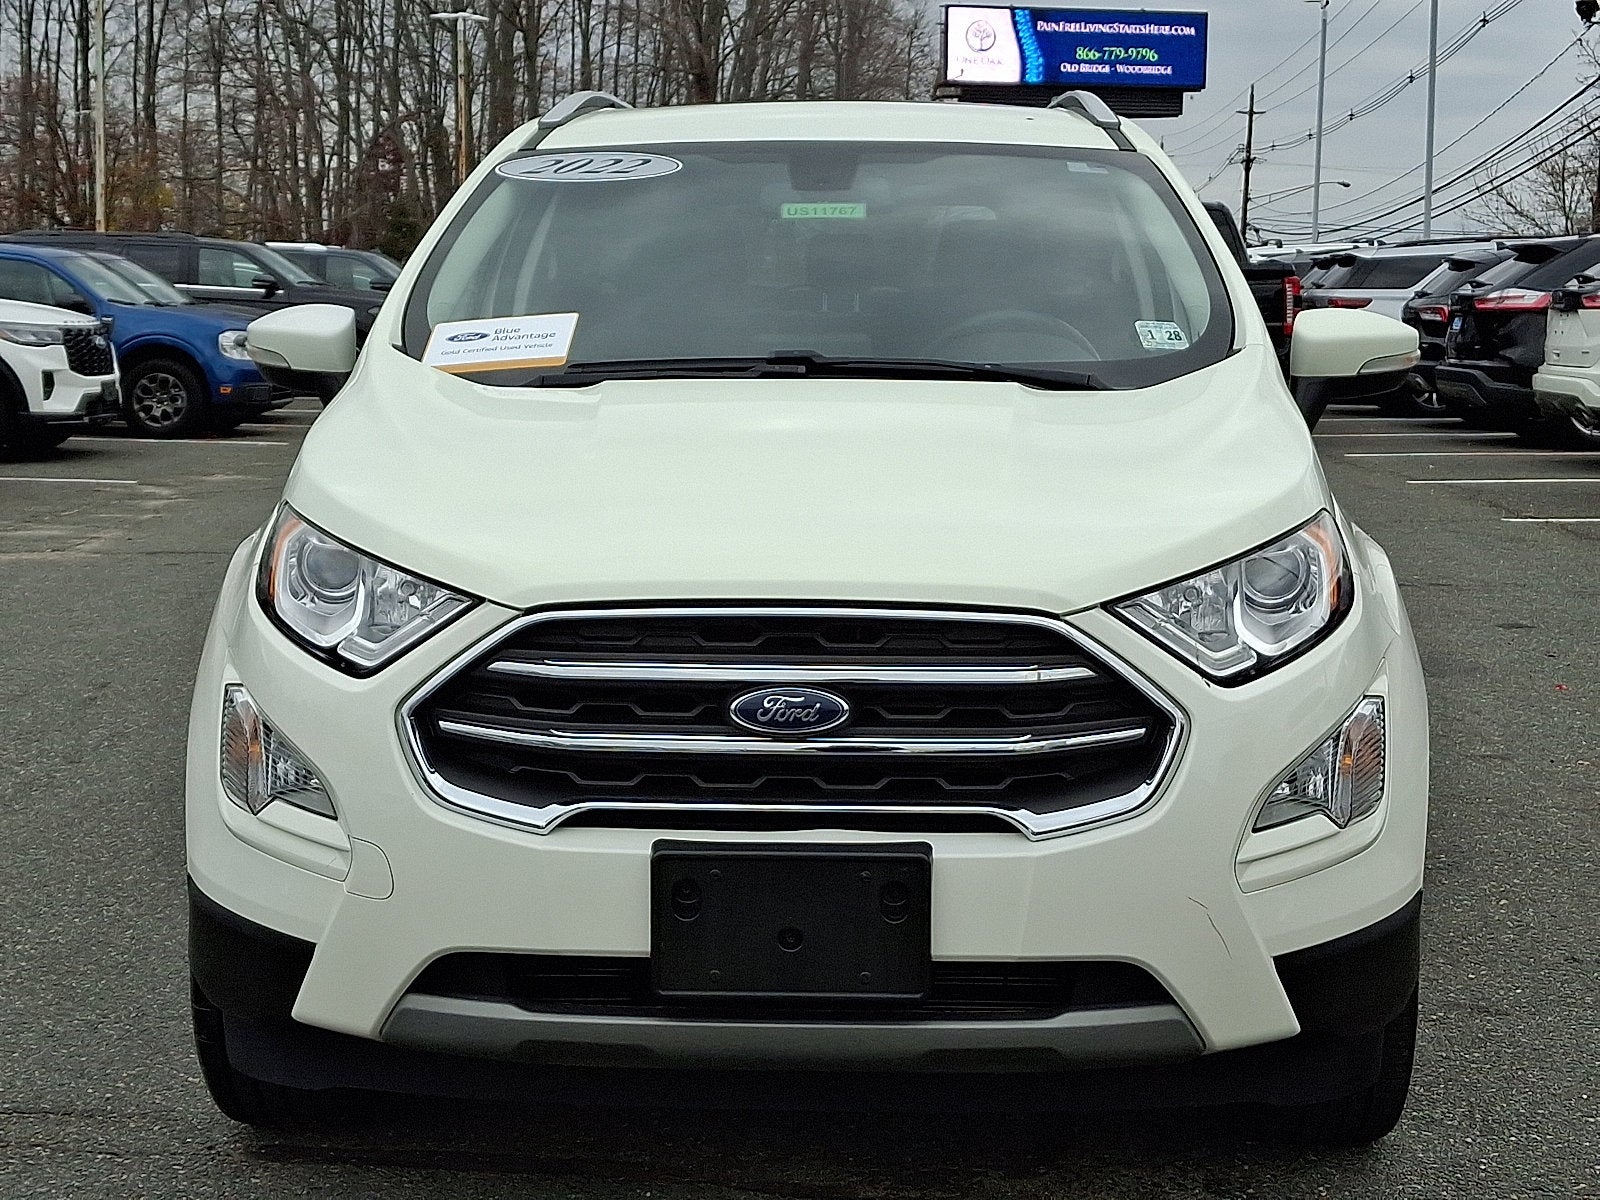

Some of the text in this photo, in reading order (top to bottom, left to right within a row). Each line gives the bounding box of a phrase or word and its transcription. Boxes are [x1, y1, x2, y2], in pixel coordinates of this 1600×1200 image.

[1075, 47, 1158, 61] 866-779-9796
[519, 157, 652, 174] 2022
[787, 206, 857, 216] US11767
[491, 331, 556, 341] Advantage
[1147, 330, 1183, 341] 1 28
[462, 346, 498, 354] Certified
[756, 695, 821, 722] Ford
